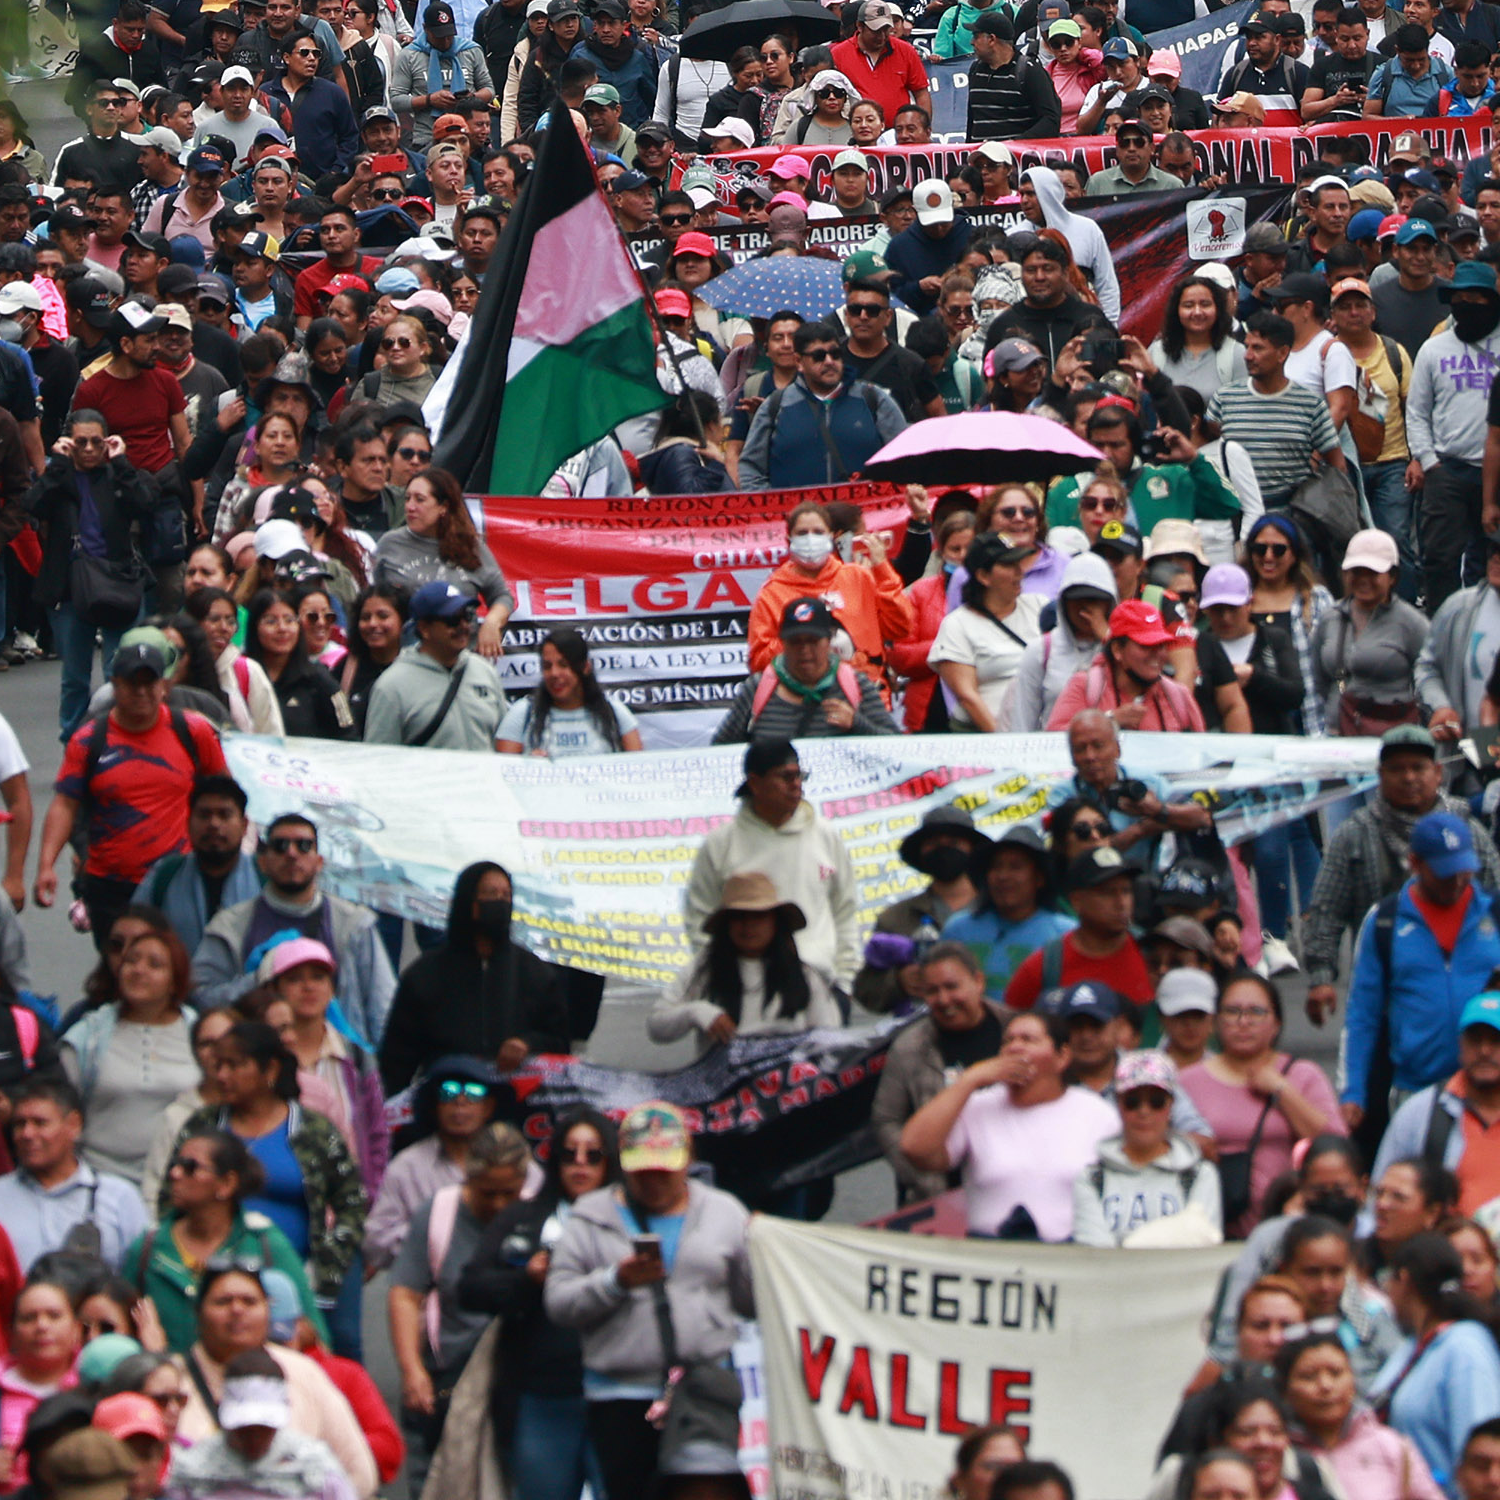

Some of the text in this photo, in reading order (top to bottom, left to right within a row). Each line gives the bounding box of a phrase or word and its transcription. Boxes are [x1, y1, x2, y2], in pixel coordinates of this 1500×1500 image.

[692, 546, 789, 569] CHIAP
[672, 621, 704, 638] DE
[711, 618, 744, 637] LA
[631, 652, 660, 669] LA
[667, 650, 712, 669] LEY
[866, 1264, 1057, 1330] REGIÓN
[798, 1327, 1032, 1445] VALLE
